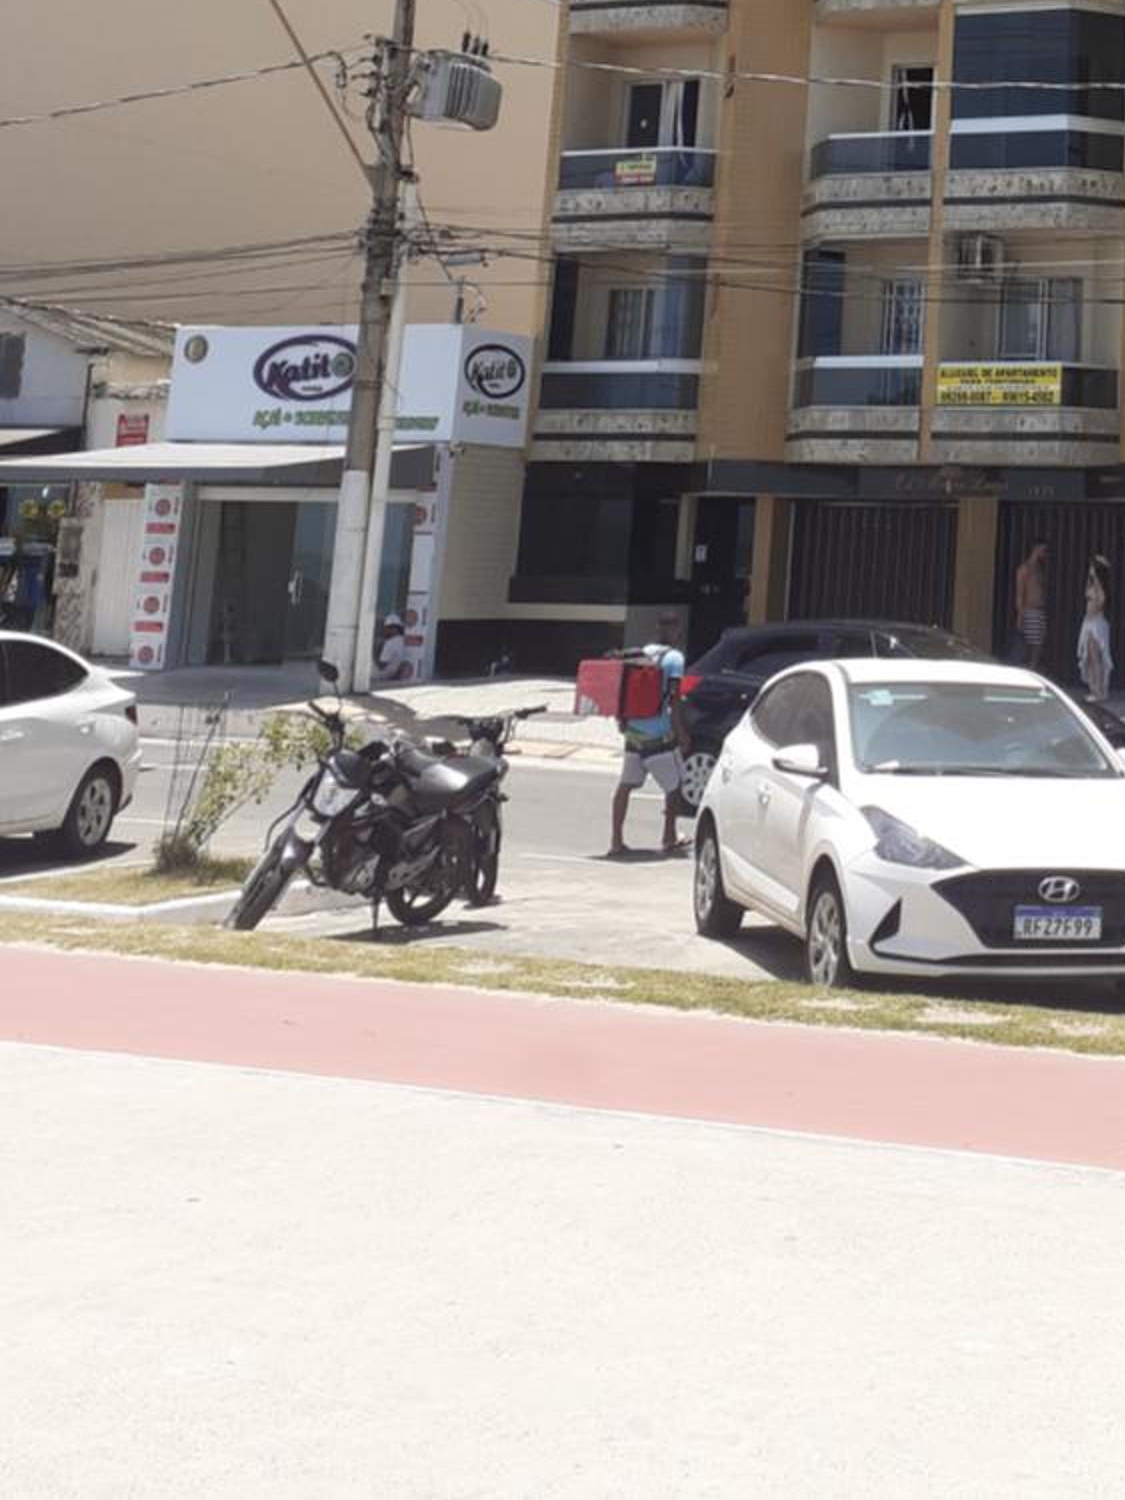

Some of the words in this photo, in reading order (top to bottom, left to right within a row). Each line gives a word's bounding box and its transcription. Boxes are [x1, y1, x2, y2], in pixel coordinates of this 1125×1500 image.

[940, 367, 978, 377] ALUGUEL
[981, 367, 993, 377] DE
[995, 367, 1057, 377] APARTAMENTO
